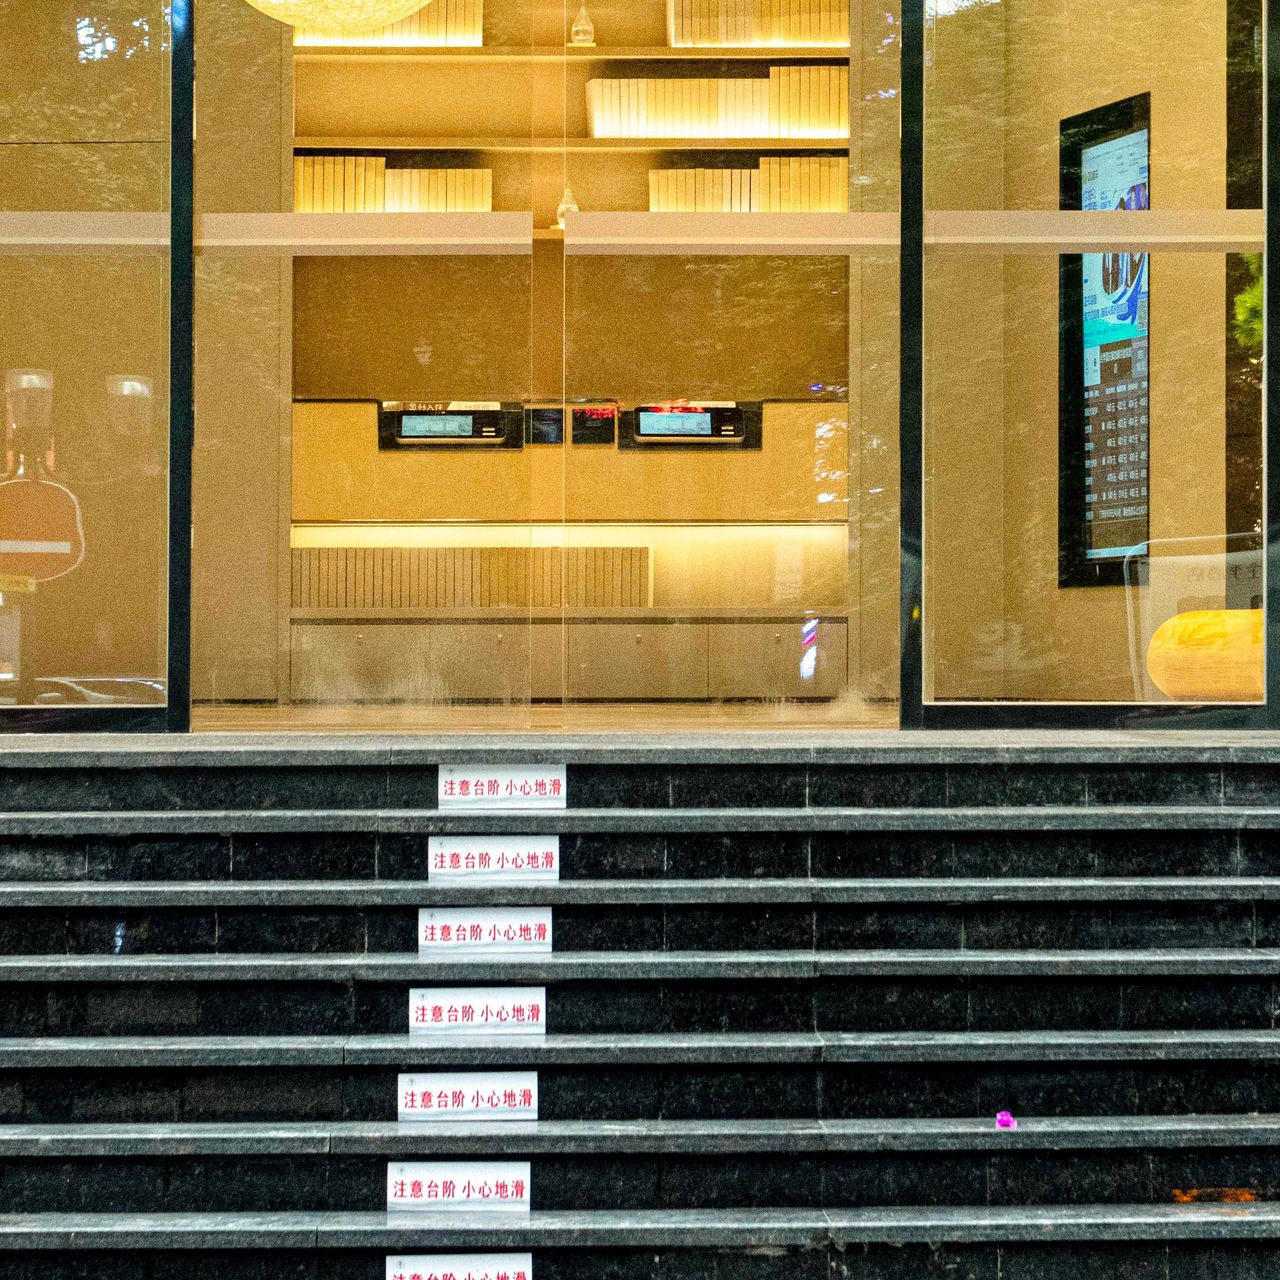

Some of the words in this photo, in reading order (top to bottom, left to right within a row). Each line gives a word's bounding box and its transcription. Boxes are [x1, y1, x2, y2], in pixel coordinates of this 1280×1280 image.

[443, 779, 500, 796] 注意台阶
[504, 778, 561, 797] 小心地滑
[433, 852, 492, 869] 注意台阶
[496, 851, 555, 869] 小心地滑
[423, 924, 483, 942] 注意台阶
[488, 923, 547, 942] 小心地滑
[414, 1005, 475, 1023] 注意台阶
[480, 1003, 541, 1023] 小心地滑
[404, 1090, 465, 1109] 注意台阶
[470, 1088, 533, 1108] 小心地滑
[392, 1179, 456, 1199] 注意台阶
[462, 1179, 525, 1199] 小心地滑
